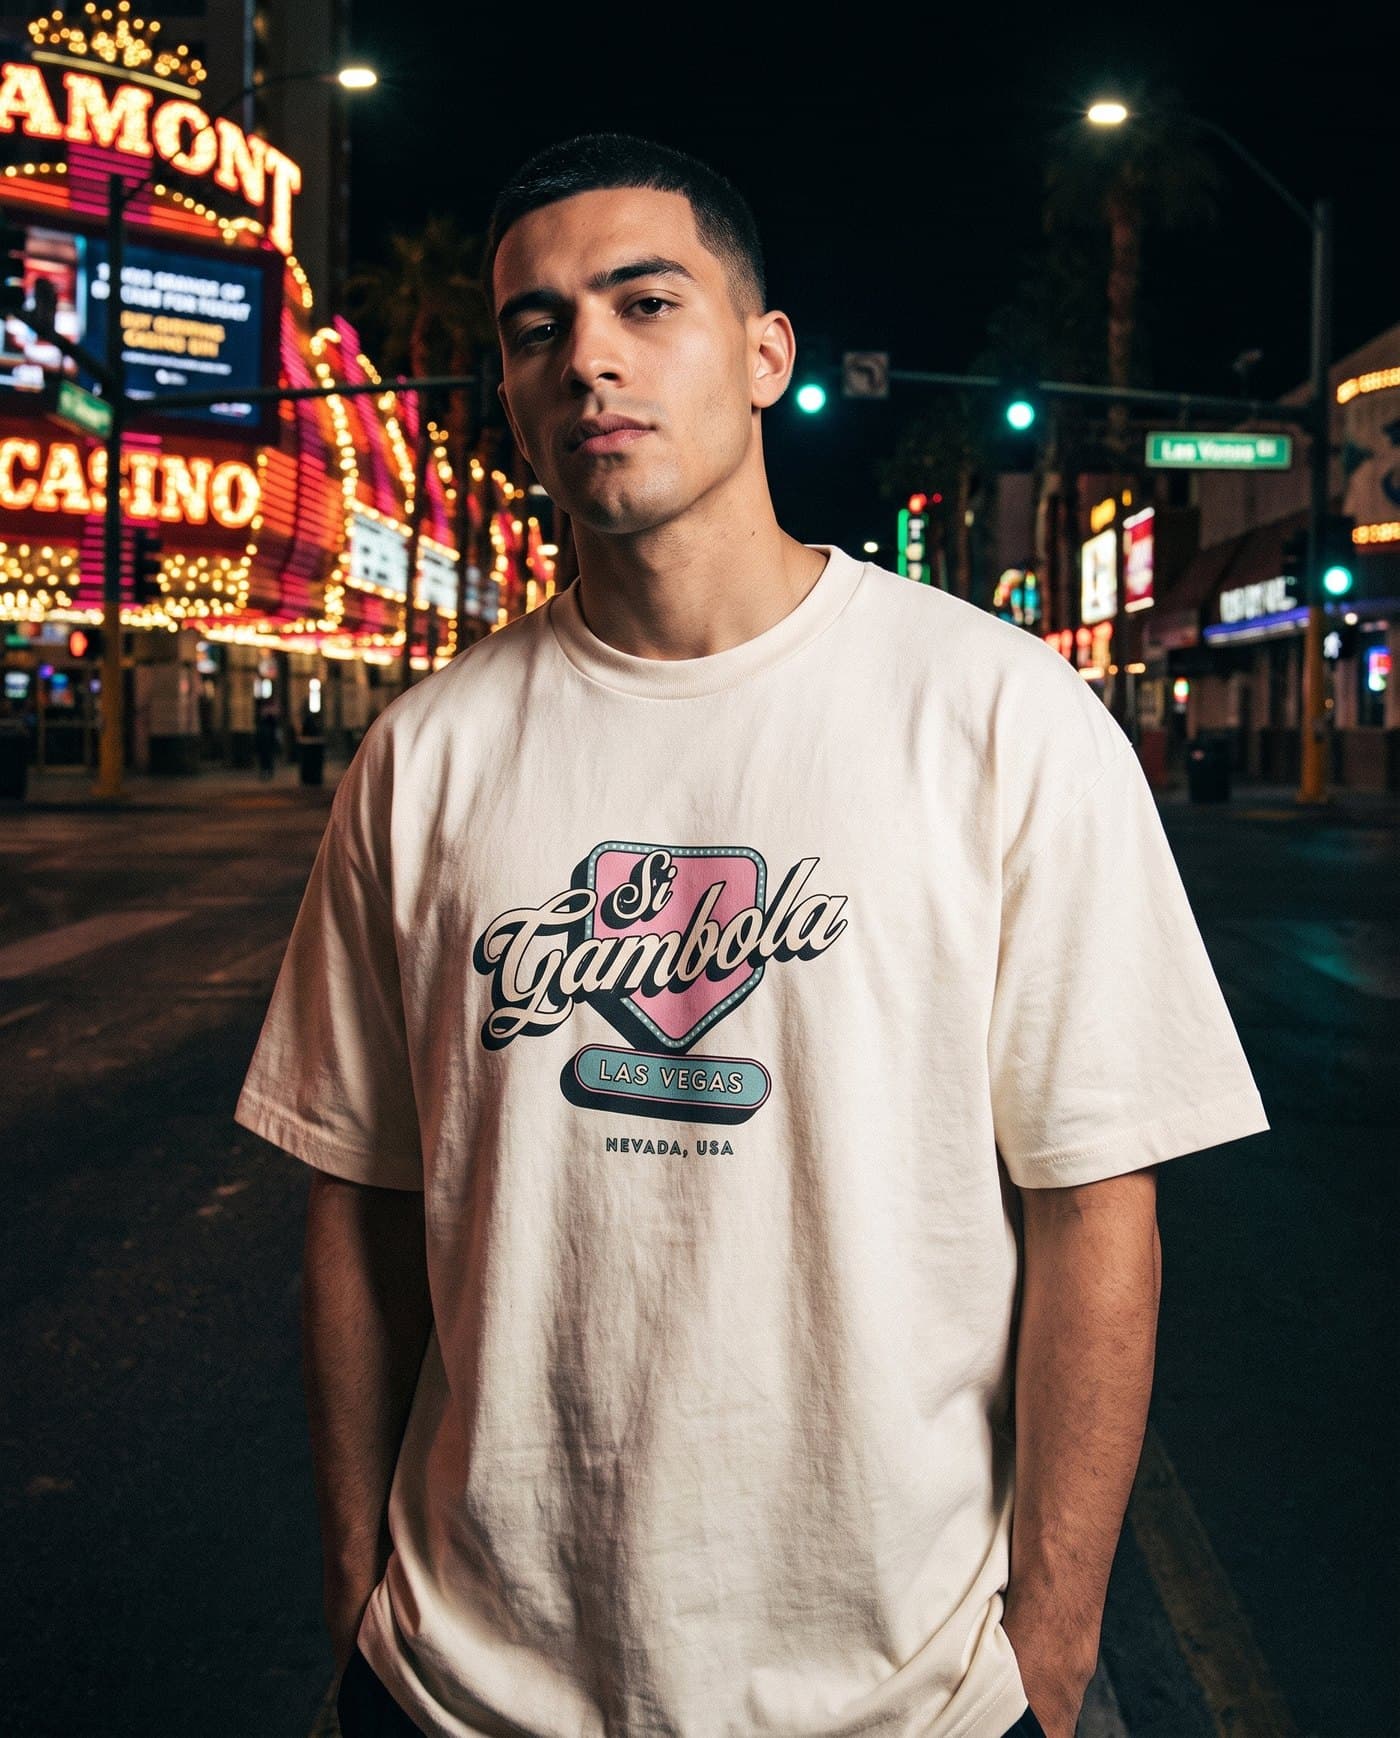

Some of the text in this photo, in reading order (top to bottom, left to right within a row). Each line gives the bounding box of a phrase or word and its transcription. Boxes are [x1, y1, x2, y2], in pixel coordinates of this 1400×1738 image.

[0, 62, 301, 255] AMONT
[0, 437, 262, 528] CASINO
[606, 849, 678, 924] Si
[478, 857, 848, 1046] Gambola
[600, 1059, 744, 1094] LAS VEGAS
[606, 1137, 734, 1158] NEVADA, USA
